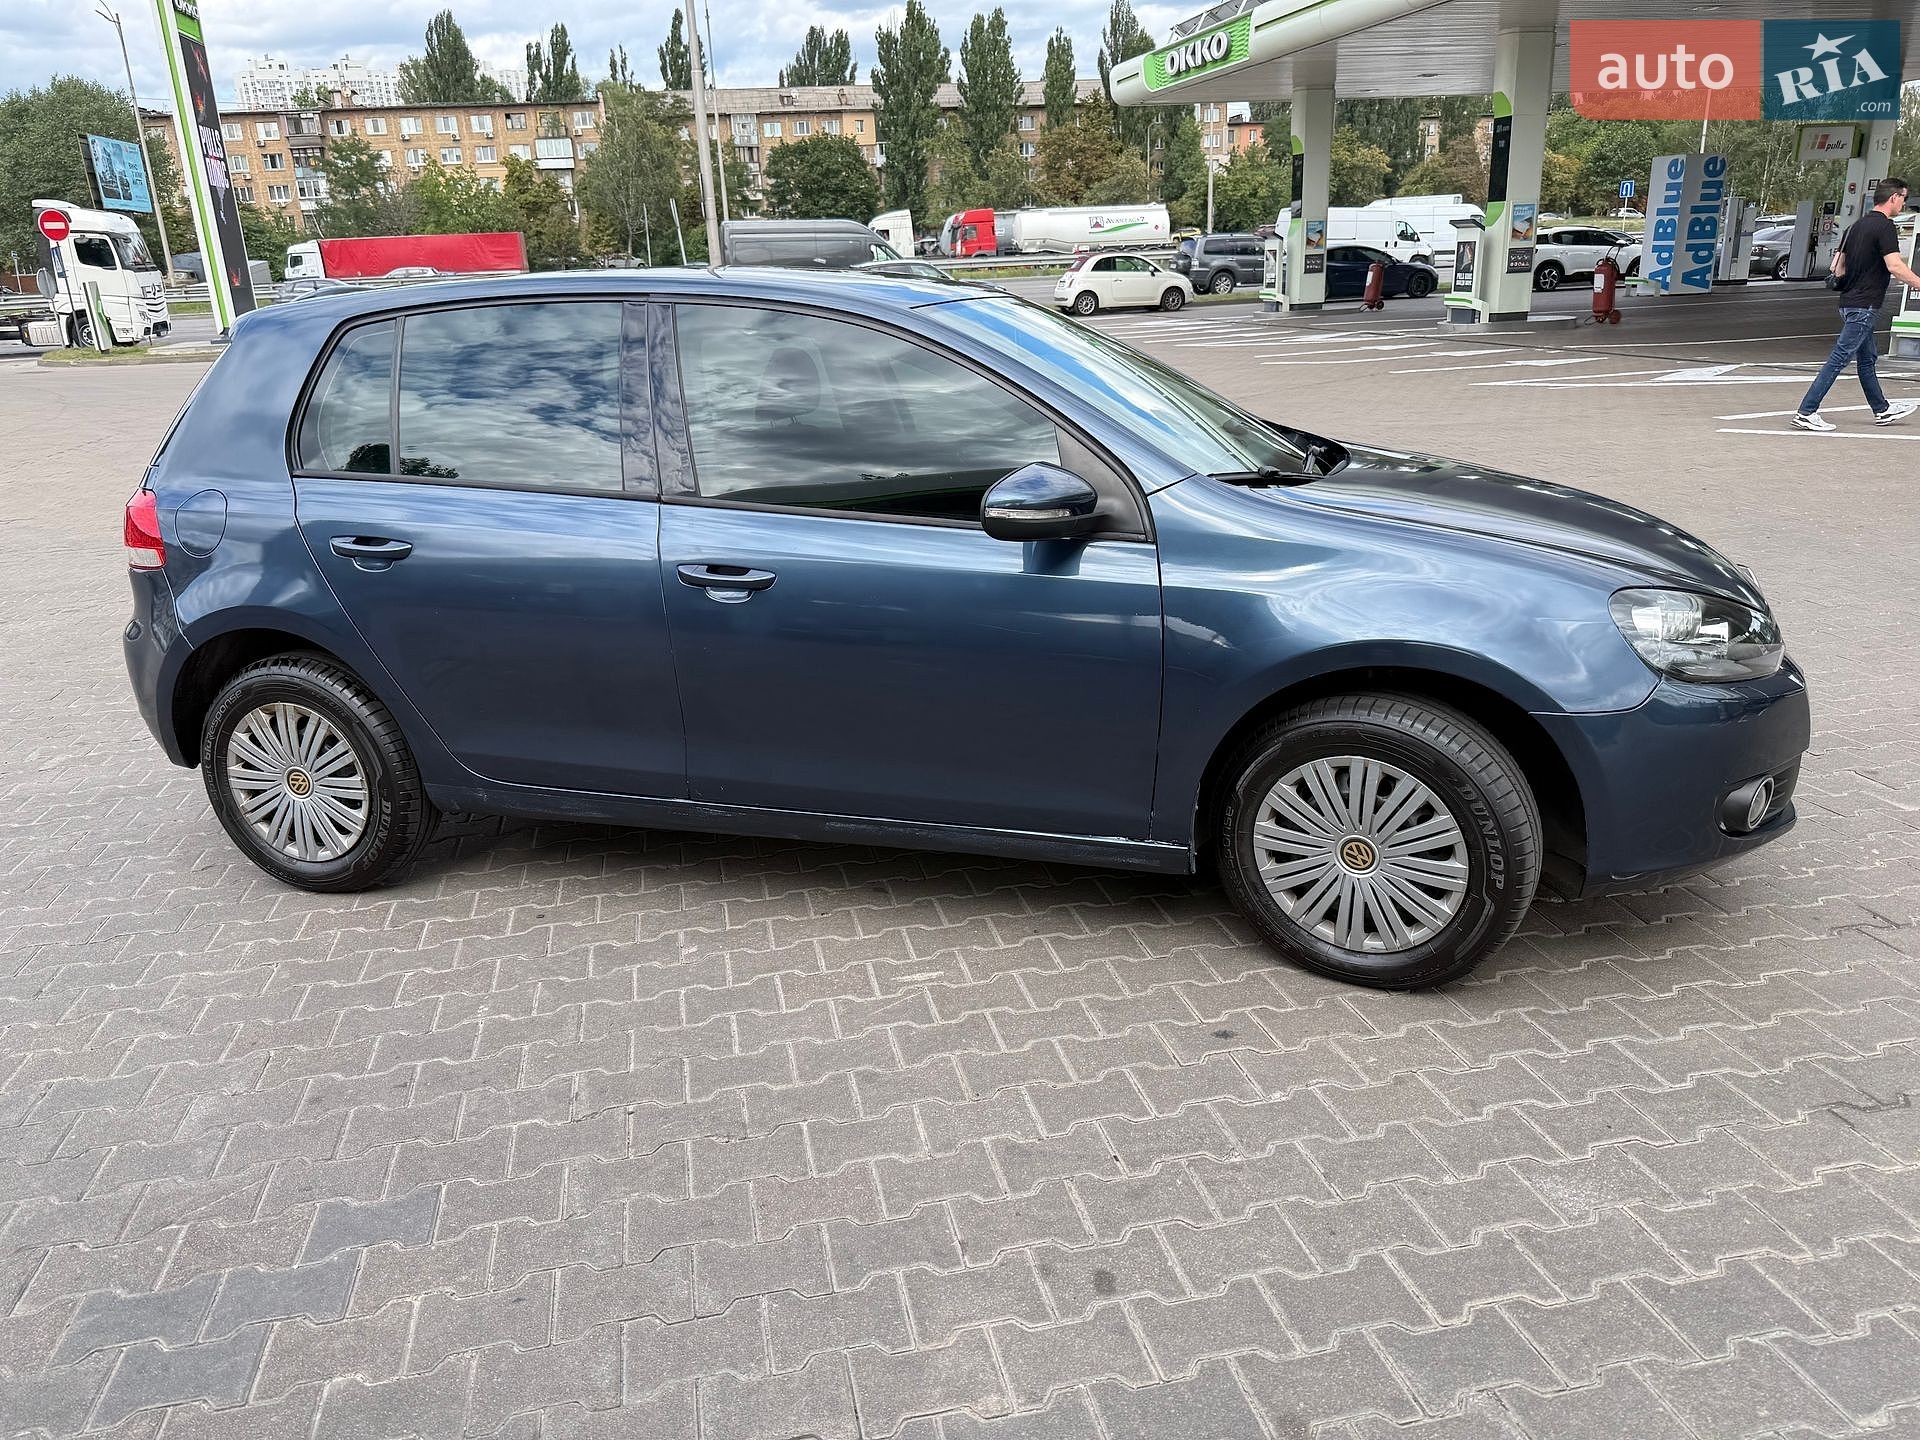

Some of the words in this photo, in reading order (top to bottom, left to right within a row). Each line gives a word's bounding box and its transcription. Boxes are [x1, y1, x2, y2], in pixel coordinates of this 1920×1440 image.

[1165, 31, 1231, 76] OKKO
[1825, 140, 1847, 152] pulls
[1875, 138, 1888, 151] 15
[1648, 158, 1685, 291] AdBlue
[1681, 156, 1726, 290] AdBlue
[1461, 783, 1505, 890] DUNLOP
